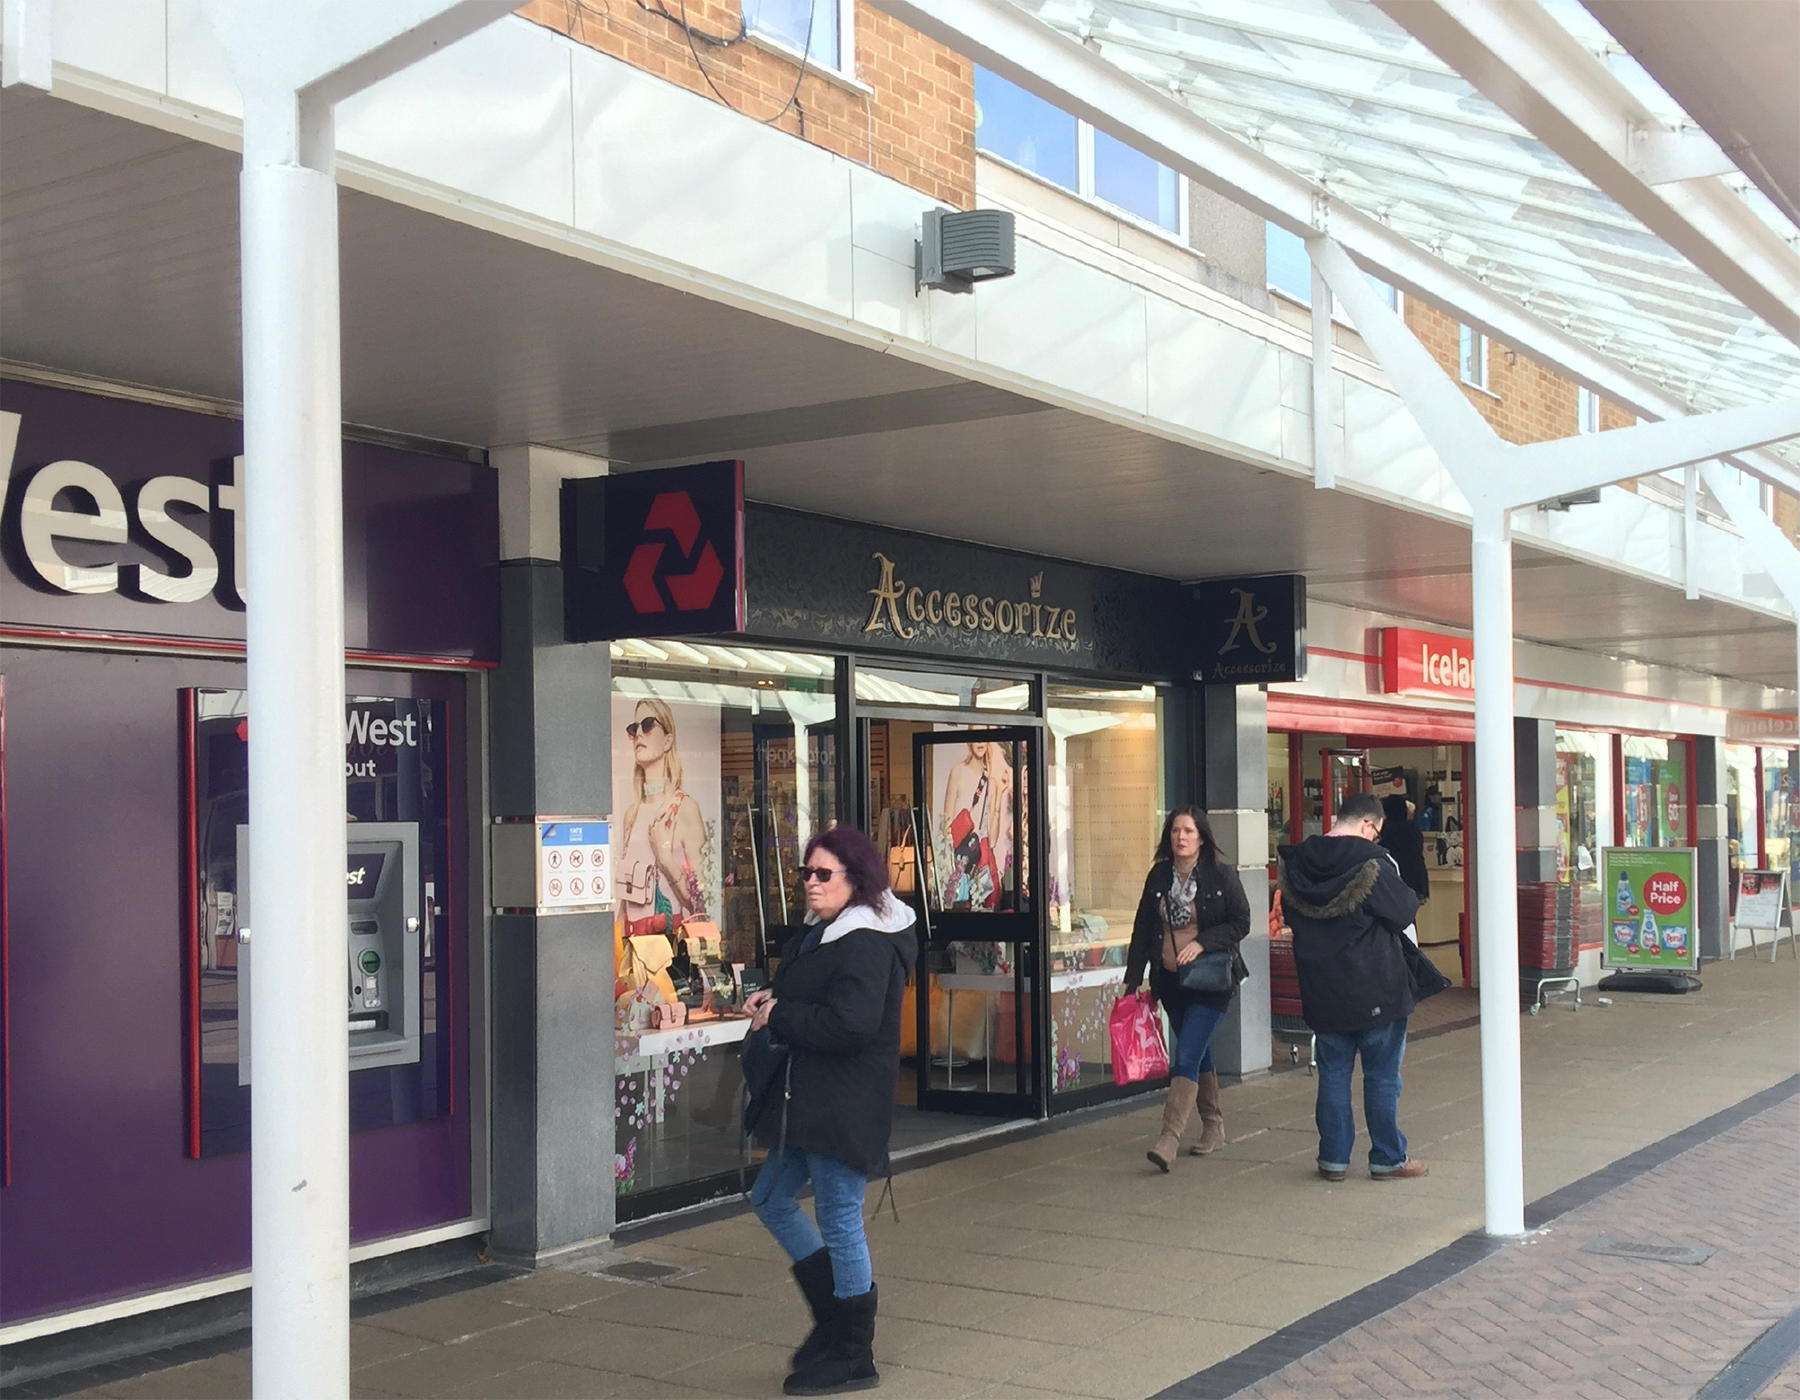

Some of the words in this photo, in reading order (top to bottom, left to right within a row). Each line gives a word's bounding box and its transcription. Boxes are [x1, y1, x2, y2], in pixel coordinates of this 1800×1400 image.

[0, 411, 247, 606] es
[864, 551, 1077, 640] Accessorize
[1217, 587, 1278, 656] A
[1650, 892, 1681, 904] Price
[1652, 880, 1680, 892] Half
